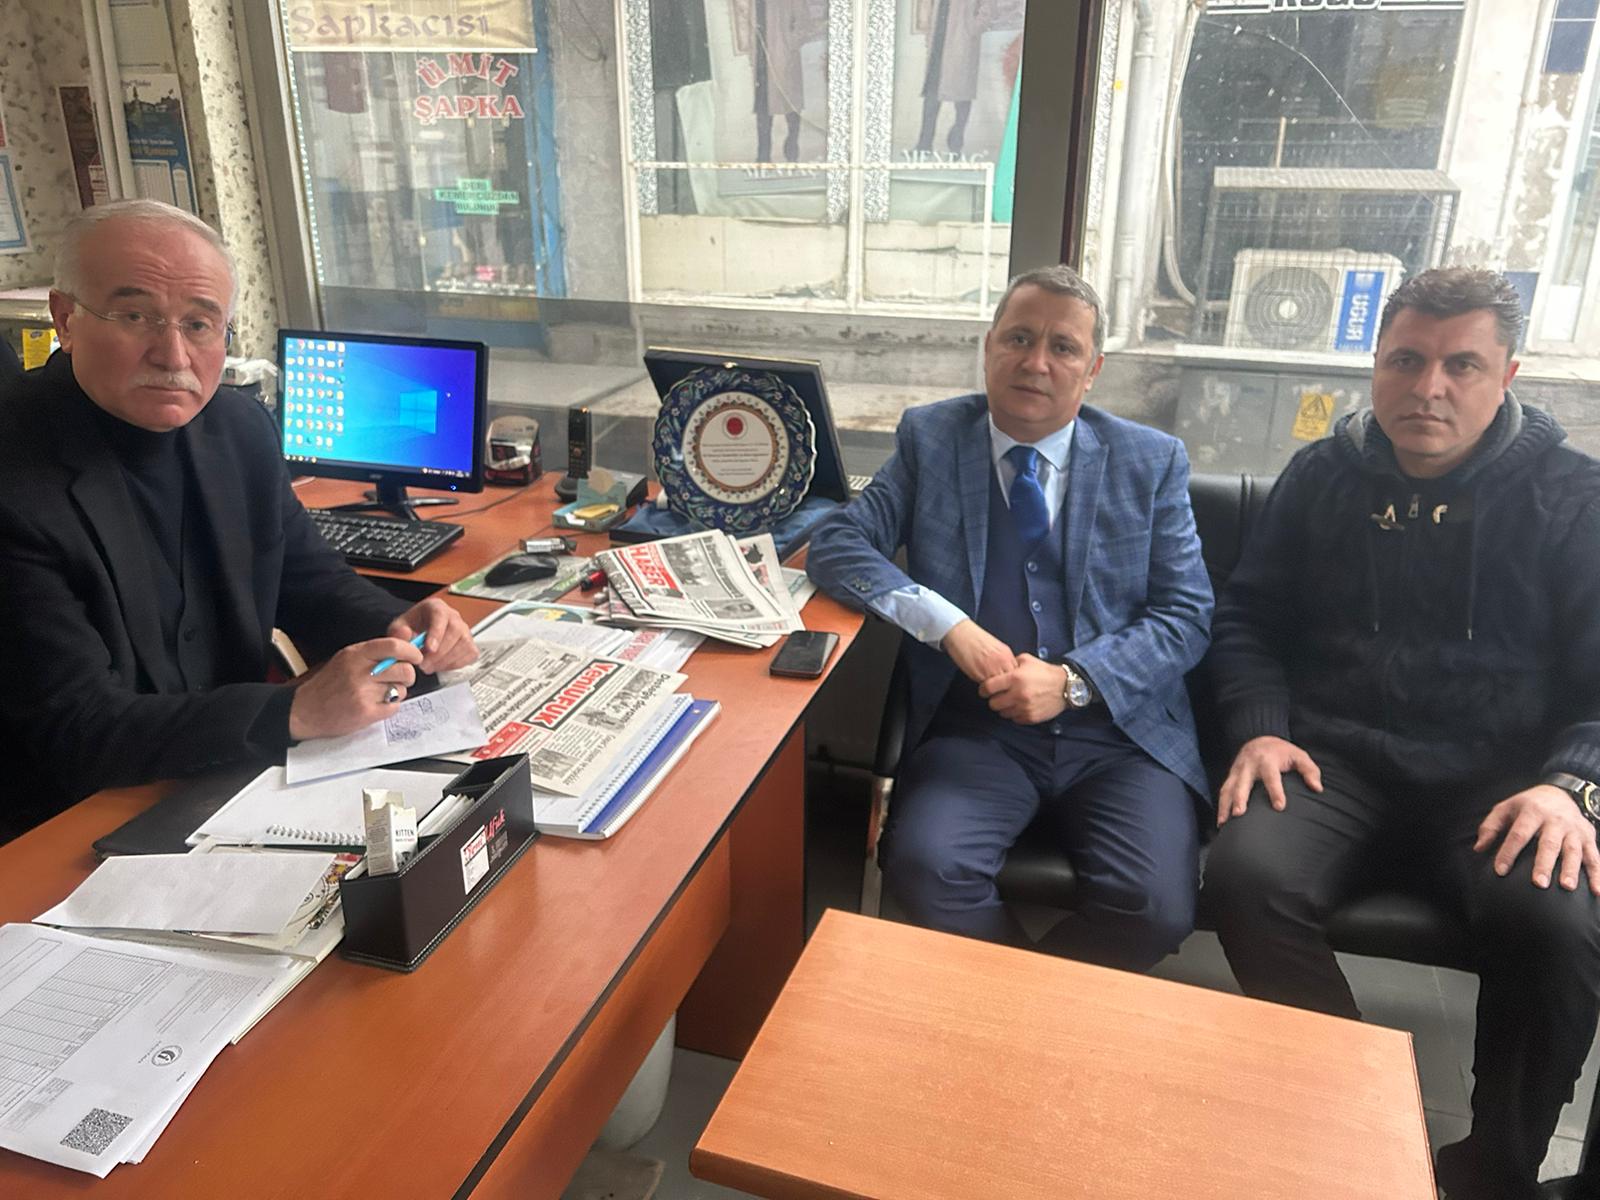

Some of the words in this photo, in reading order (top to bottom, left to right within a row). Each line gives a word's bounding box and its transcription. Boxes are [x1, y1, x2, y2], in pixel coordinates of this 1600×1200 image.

[290, 4, 489, 43] Şapkacısı
[414, 95, 525, 125] ŞAPKA
[629, 546, 666, 586] HABER
